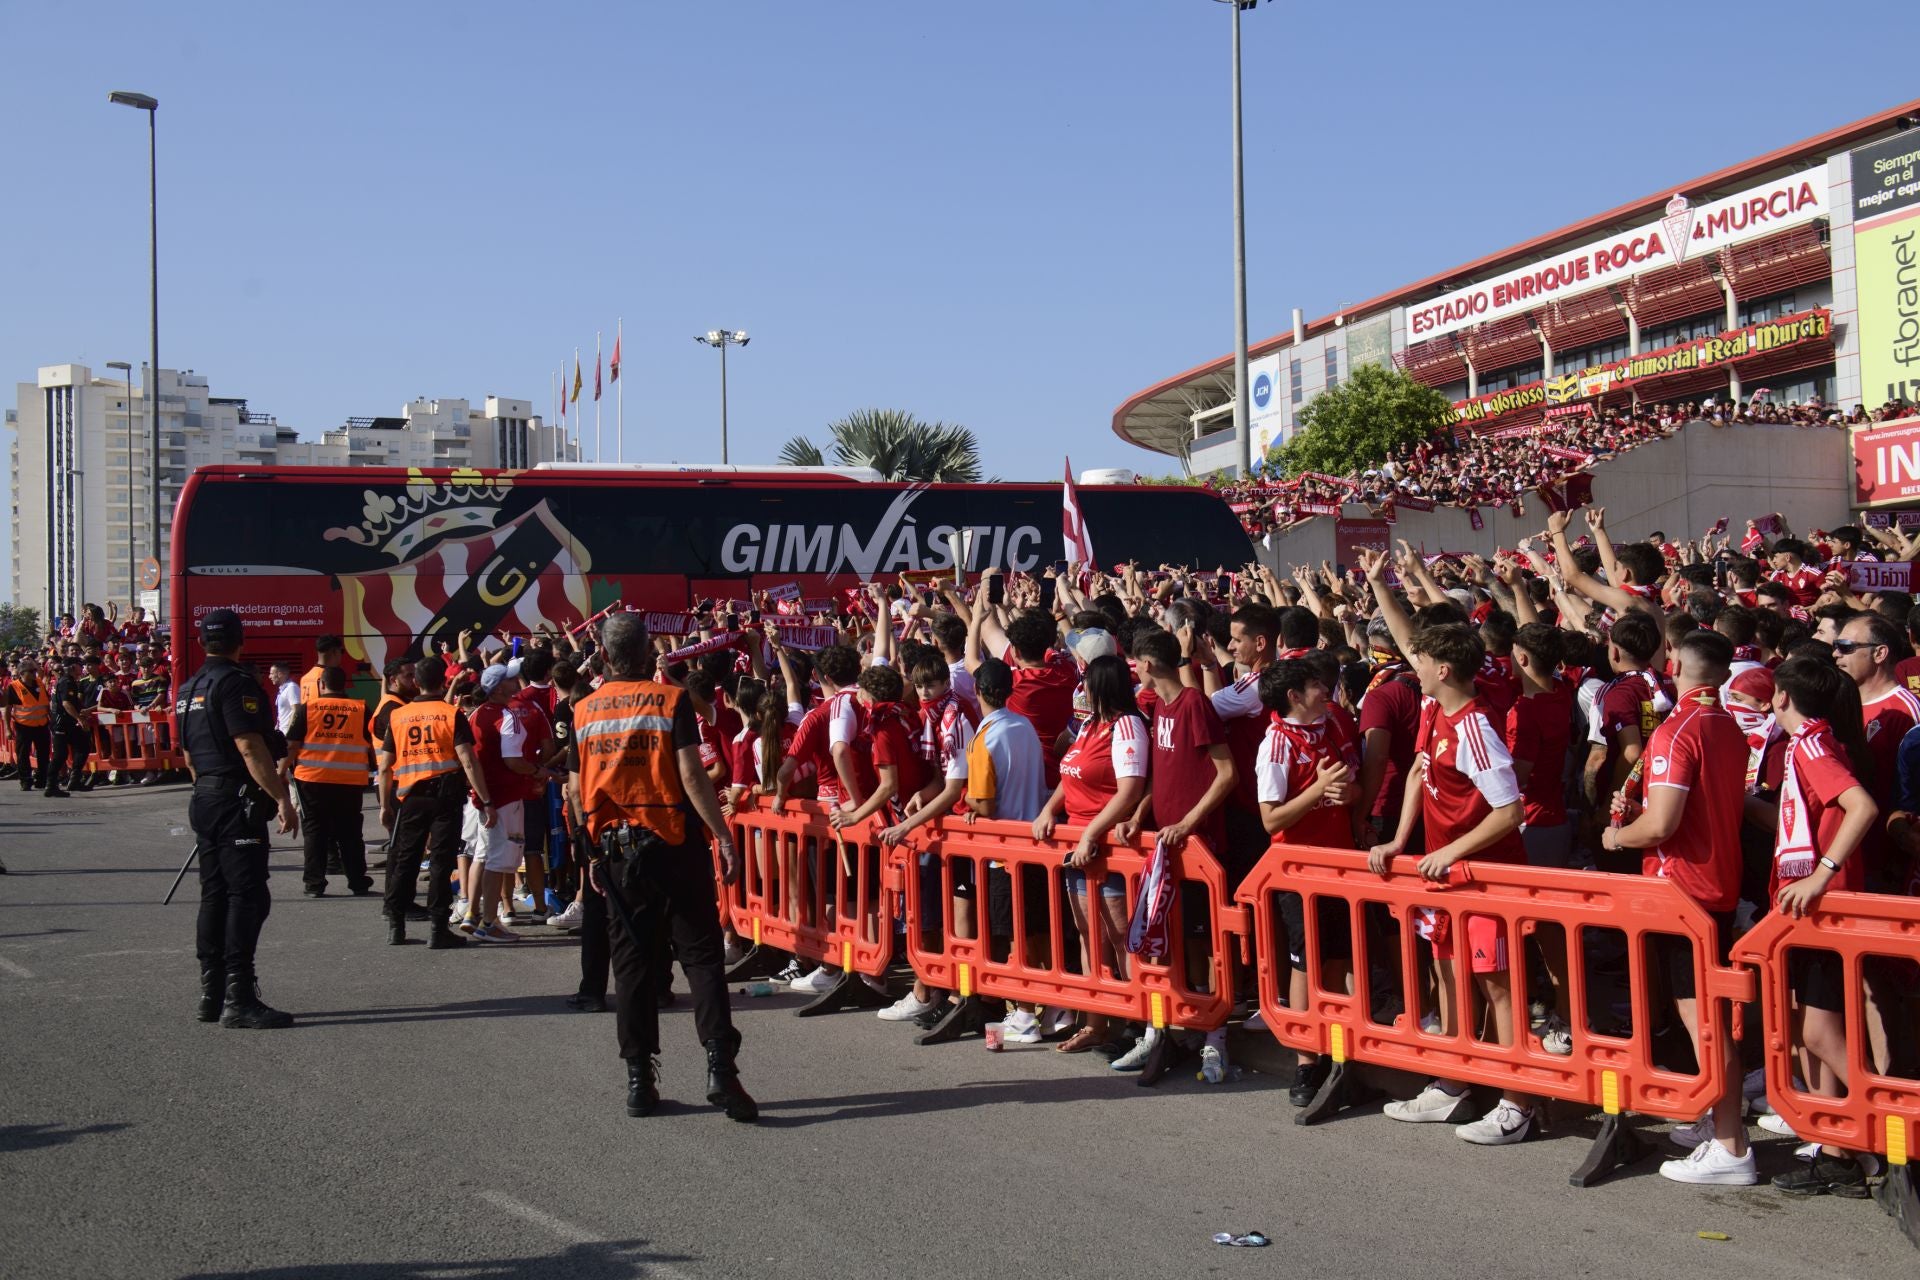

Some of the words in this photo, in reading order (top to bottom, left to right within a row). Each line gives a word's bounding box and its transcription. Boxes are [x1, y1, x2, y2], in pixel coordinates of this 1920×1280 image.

[1884, 173, 1900, 186] en
[1902, 165, 1914, 181] el
[1858, 189, 1895, 208] mejor
[1412, 291, 1489, 334] ESTADIO
[1492, 256, 1591, 308] ENRIQUE
[1594, 232, 1666, 275] ROCA
[1707, 181, 1819, 239] MURCIA
[1891, 229, 1920, 367] fibranet
[1614, 364, 1626, 382] e
[1629, 345, 1700, 379] inmortal
[1704, 331, 1749, 364] Real
[1755, 315, 1826, 351] Murcia
[1465, 400, 1486, 420] del
[1489, 386, 1544, 417] glorioso
[721, 483, 1042, 584] GIMNÀSTIC
[587, 692, 666, 714] SEGURIDAD
[323, 714, 349, 730] 97
[315, 731, 355, 740] DASSEGUR
[408, 725, 436, 746] 91
